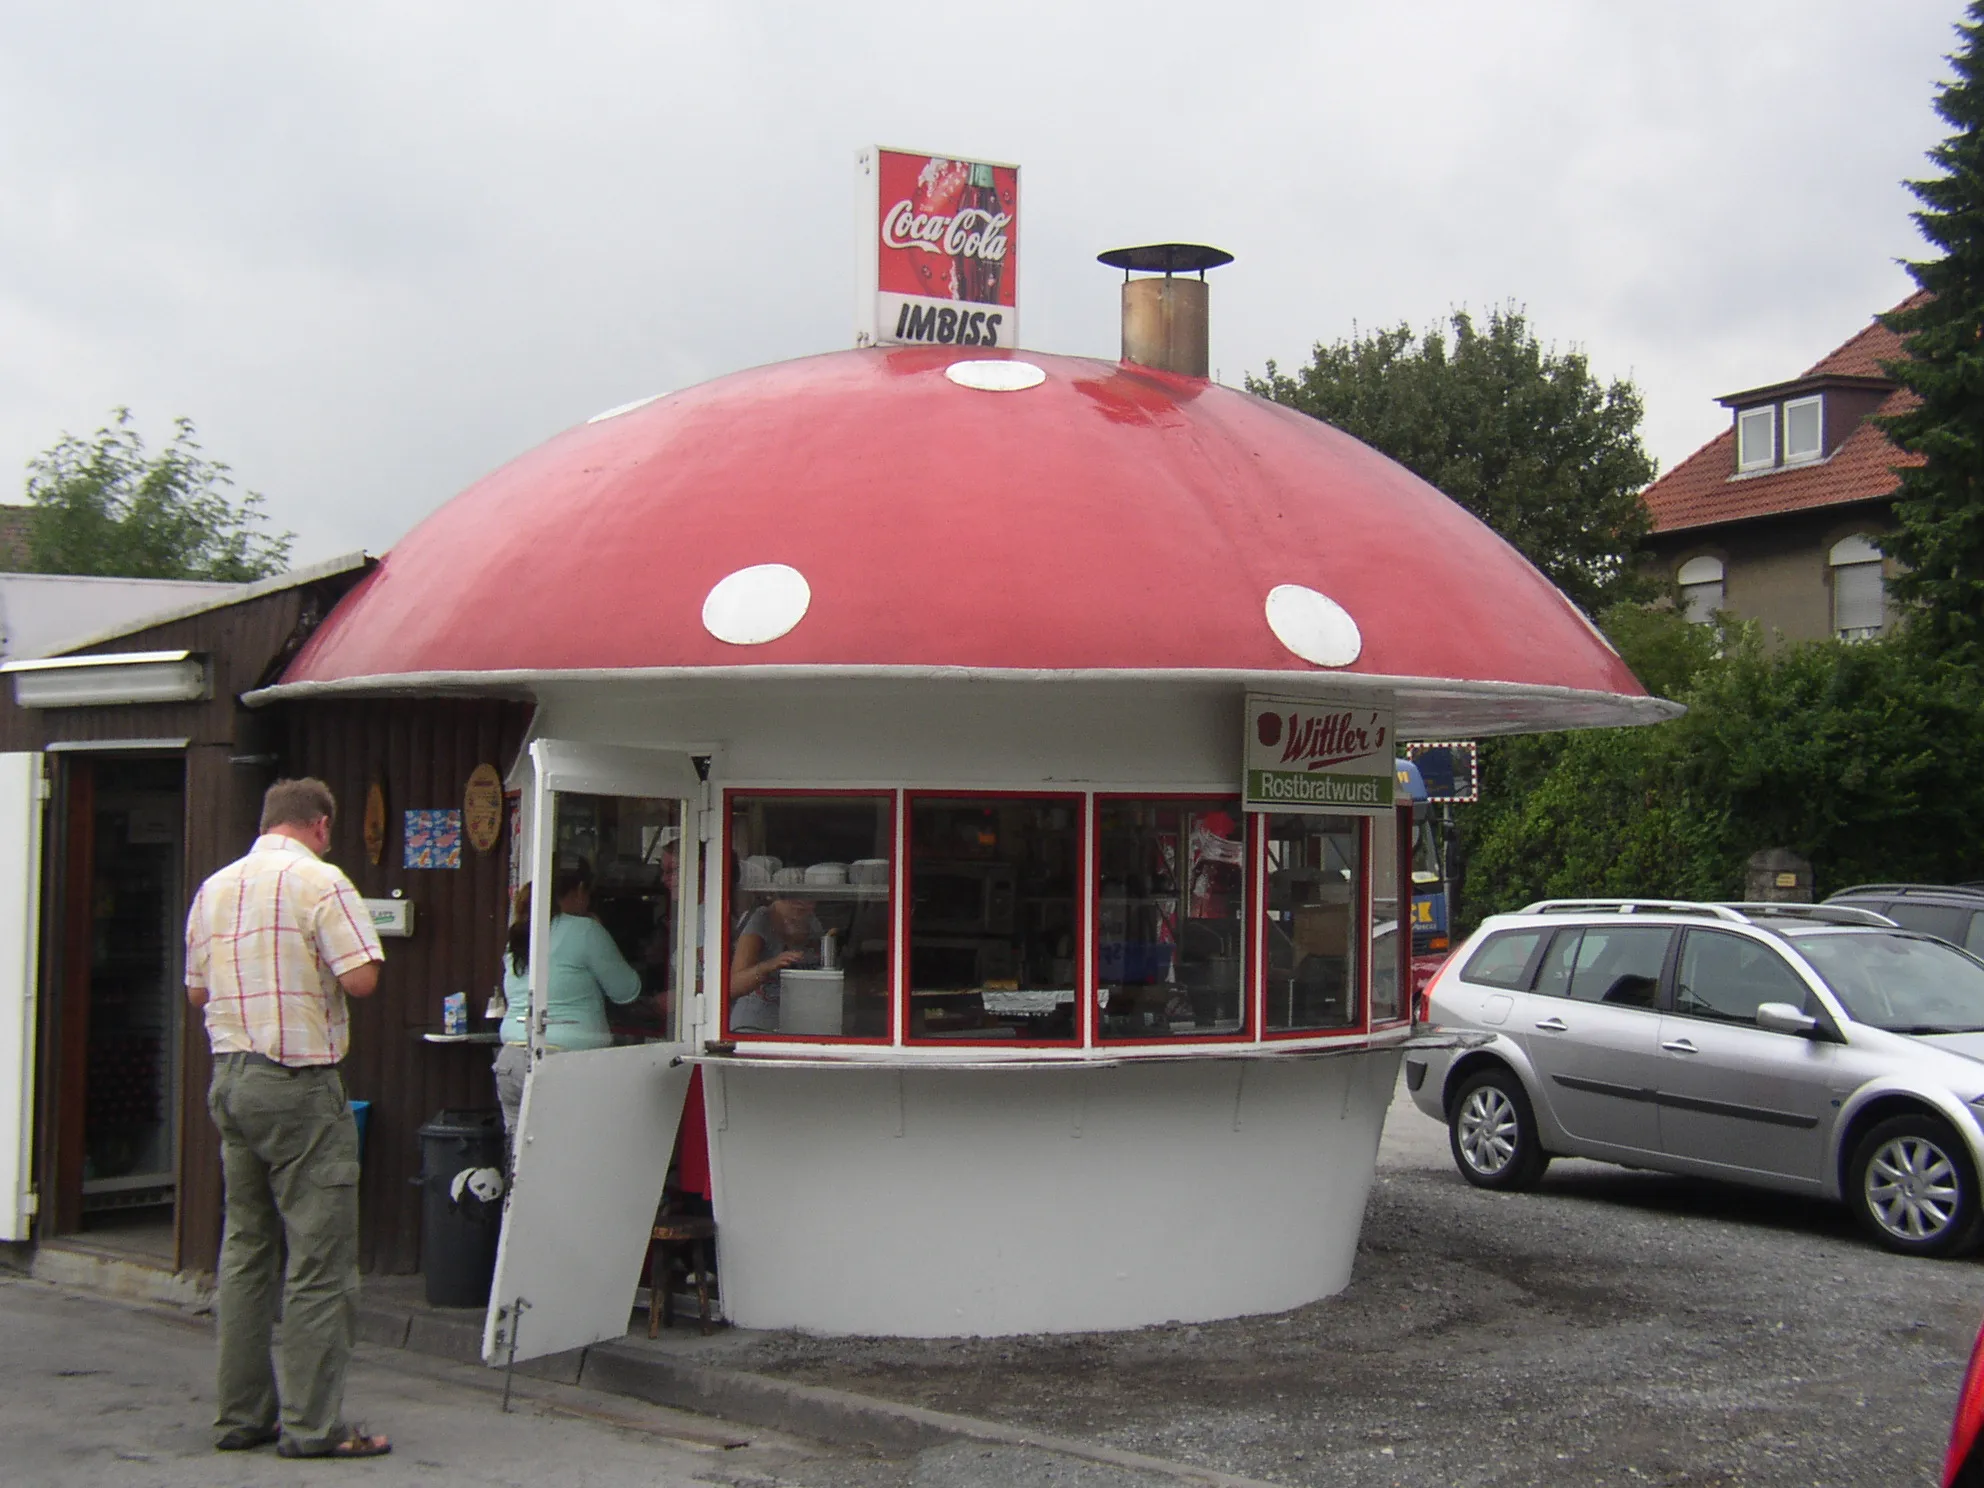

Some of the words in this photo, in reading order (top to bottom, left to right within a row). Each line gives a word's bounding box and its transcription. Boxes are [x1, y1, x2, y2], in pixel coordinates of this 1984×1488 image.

[882, 200, 1012, 261] Coca-Cola
[896, 303, 1002, 346] IMBISS
[1280, 712, 1385, 763] Wittler's
[1262, 772, 1379, 801] Rostbratwurst
